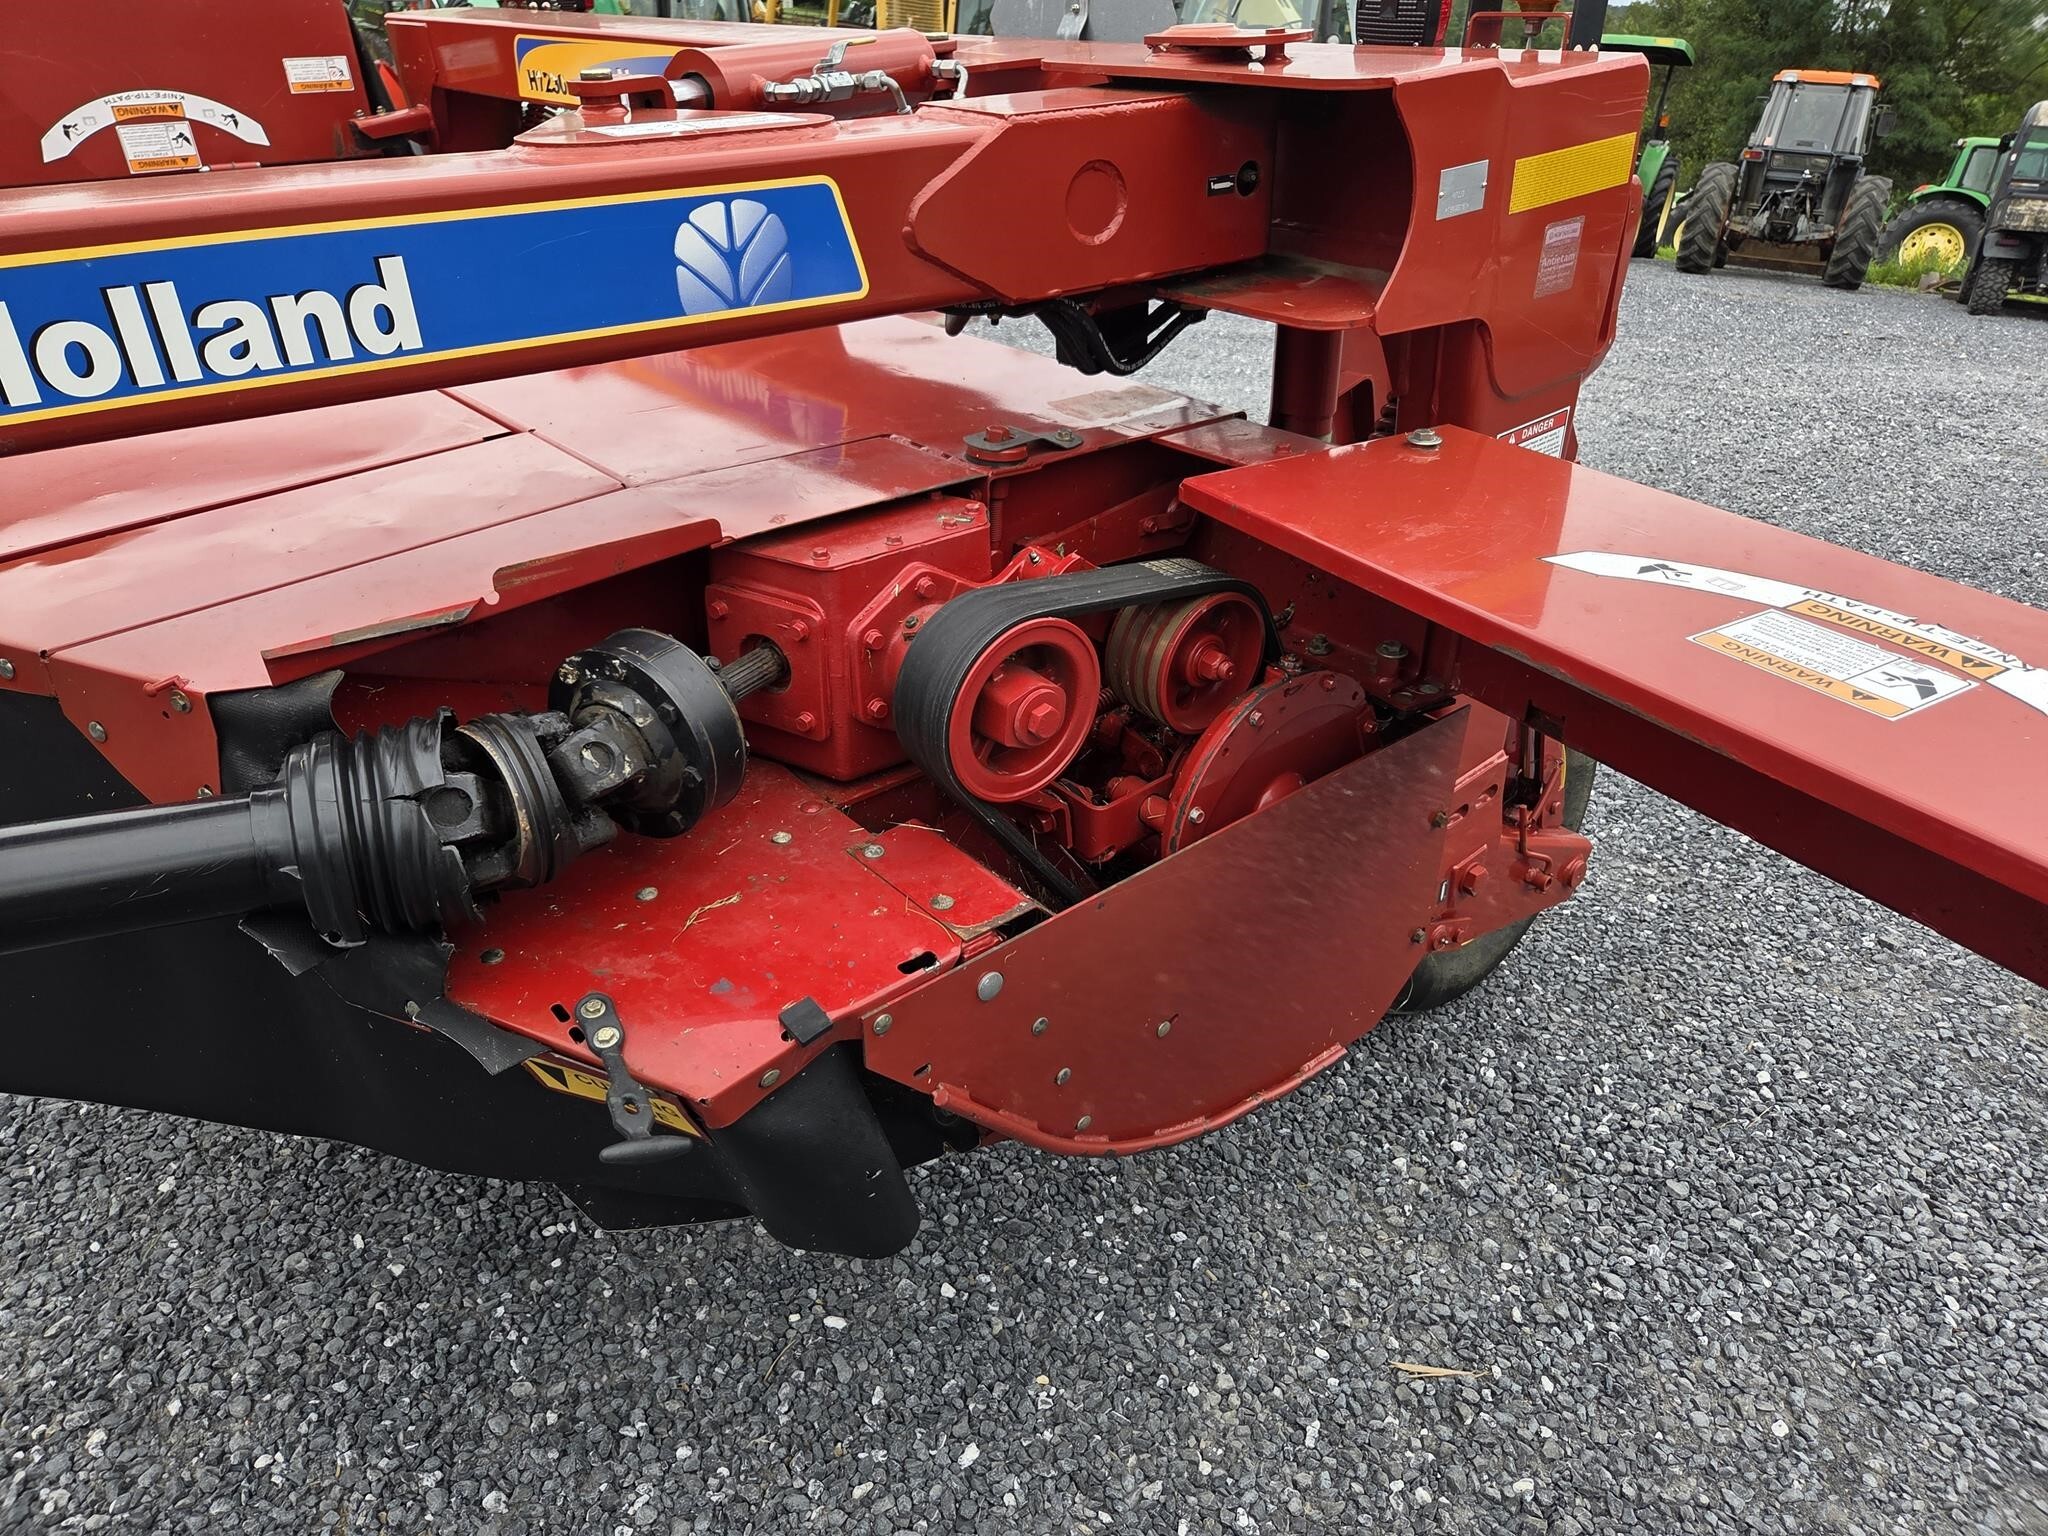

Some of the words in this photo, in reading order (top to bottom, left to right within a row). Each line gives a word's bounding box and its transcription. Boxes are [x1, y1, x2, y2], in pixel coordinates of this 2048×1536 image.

[113, 105, 169, 119] WARNING
[137, 157, 179, 170] WARNING
[1521, 418, 1555, 439] DANGER
[1807, 603, 1951, 658] WARNING
[1720, 639, 1834, 690] WARNING
[1781, 652, 1833, 674] STAND
